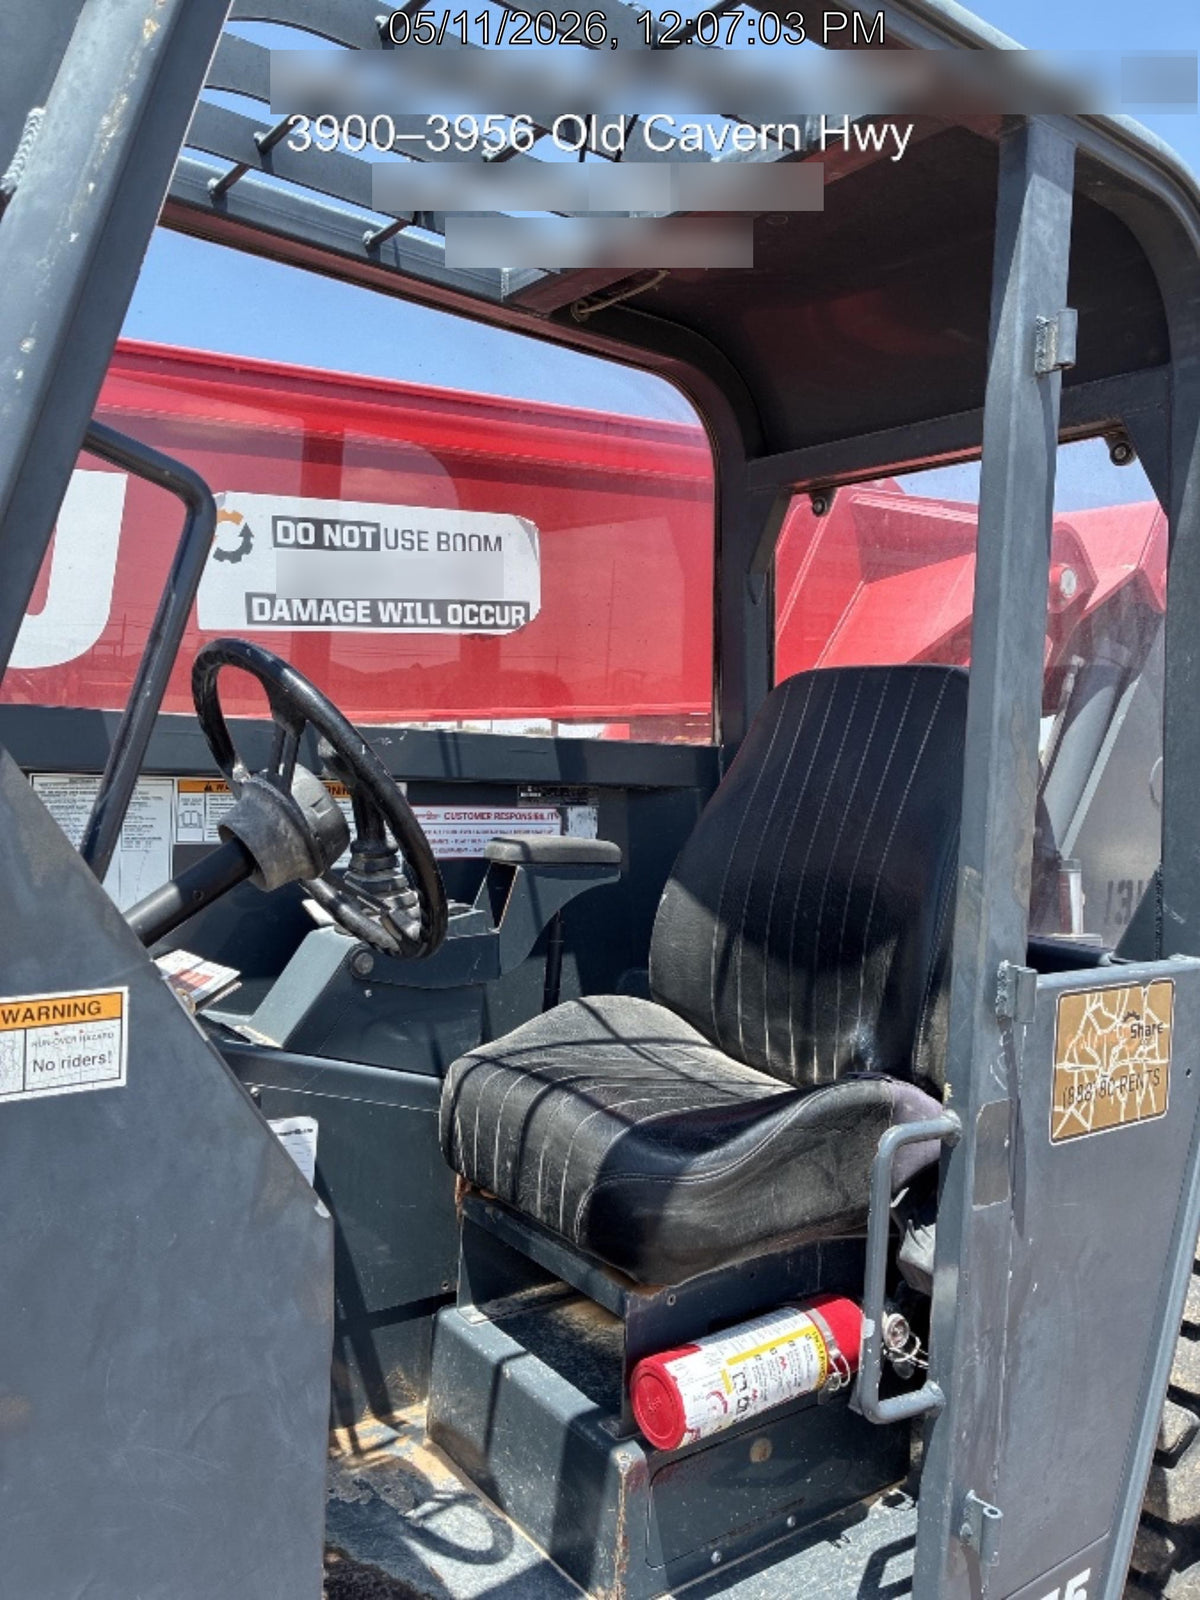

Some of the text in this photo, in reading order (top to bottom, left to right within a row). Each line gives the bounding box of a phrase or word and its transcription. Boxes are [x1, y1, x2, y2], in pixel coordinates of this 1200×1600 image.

[275, 519, 503, 552] DO NOT USE BOOM
[251, 596, 526, 627] DAMAGE WILL OCCUR
[443, 810, 492, 821] CUSTOMER
[1, 1000, 102, 1024] WARNING
[33, 1049, 113, 1073] No riders!
